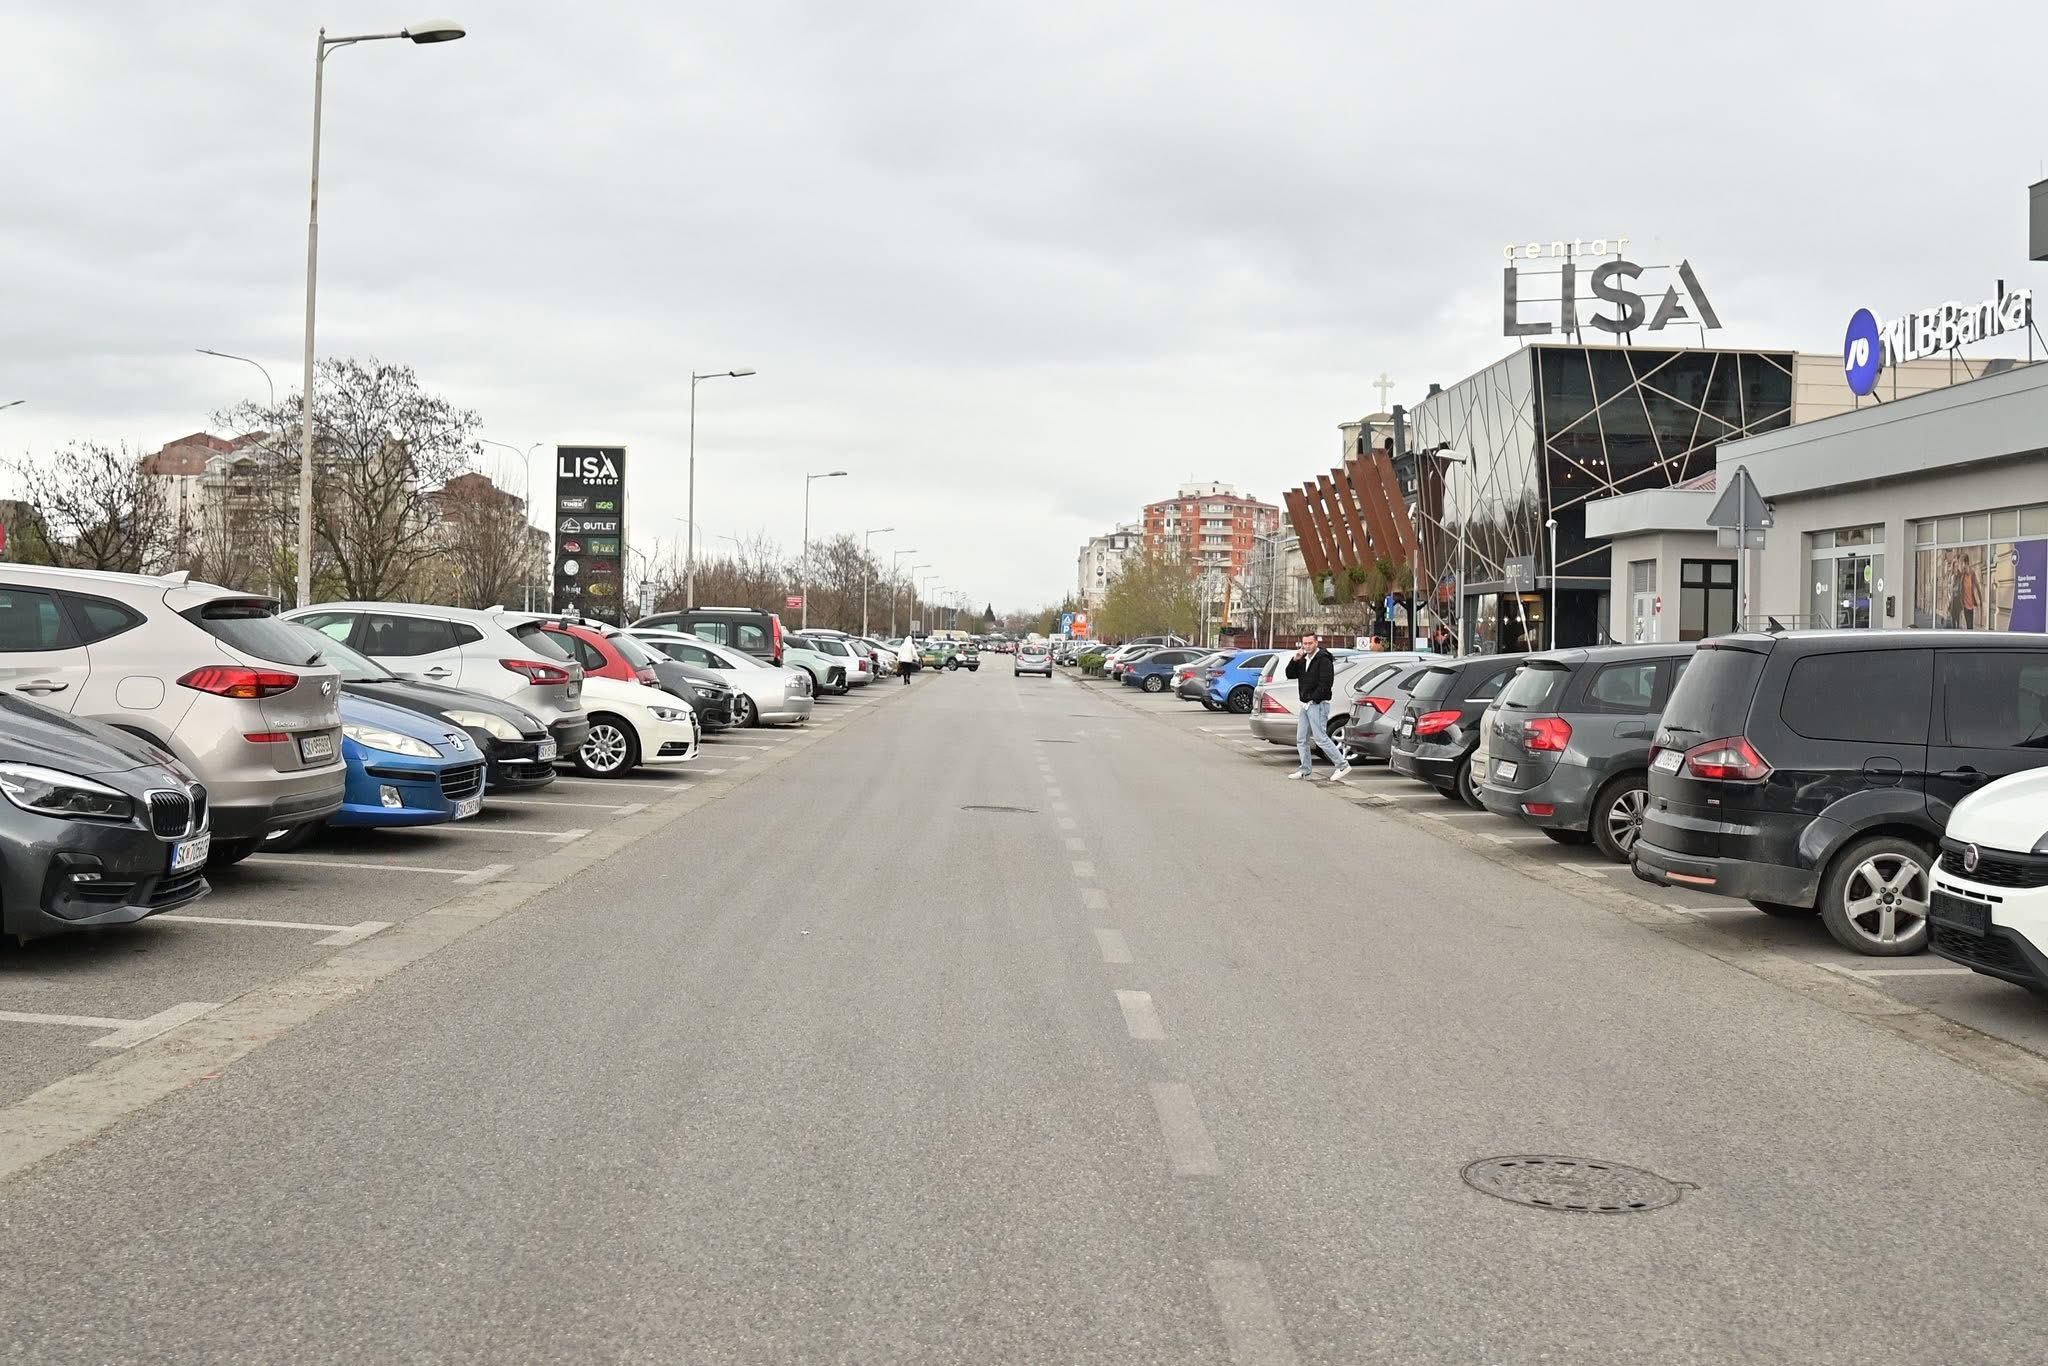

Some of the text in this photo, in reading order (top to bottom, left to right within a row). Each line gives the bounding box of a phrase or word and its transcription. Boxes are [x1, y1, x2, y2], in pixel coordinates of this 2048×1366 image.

[1503, 235, 1630, 260] centar
[1503, 258, 1722, 337] LISA
[1879, 279, 2032, 367] NLB Banka
[559, 450, 618, 478] LISA
[583, 521, 617, 530] OUTLET
